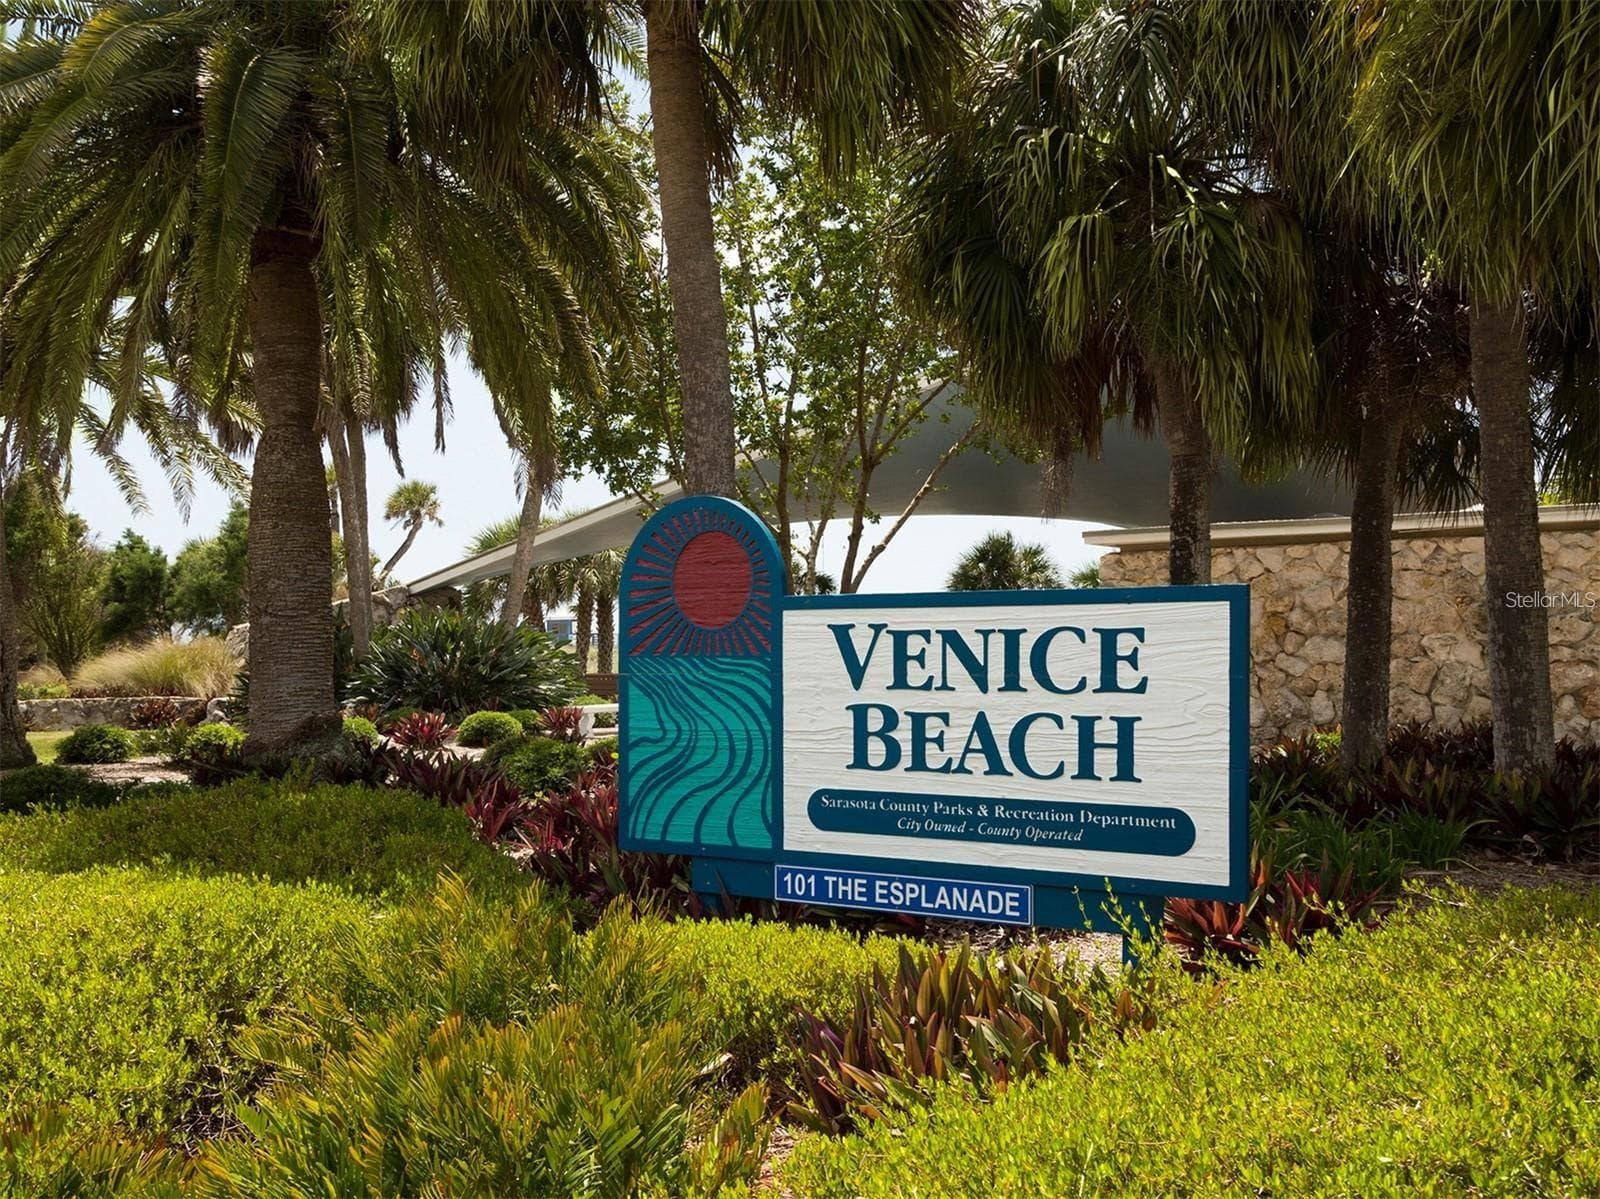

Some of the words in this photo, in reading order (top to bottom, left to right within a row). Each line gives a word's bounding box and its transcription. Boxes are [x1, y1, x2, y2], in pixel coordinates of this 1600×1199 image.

[827, 623, 1148, 695] VENICE
[846, 703, 1142, 783] BEACH
[821, 794, 876, 811] Sarasota
[879, 798, 930, 816] County
[934, 801, 973, 815] Parks
[977, 804, 989, 817] &
[995, 804, 1074, 823] Recreation
[1080, 810, 1176, 829] Department
[897, 817, 922, 833] City
[924, 818, 966, 833] Owned
[977, 822, 1022, 839] County
[1025, 825, 1084, 842] Operated
[783, 873, 816, 897] 101
[824, 876, 868, 902] THE
[875, 880, 1021, 917] ESPLANADE
